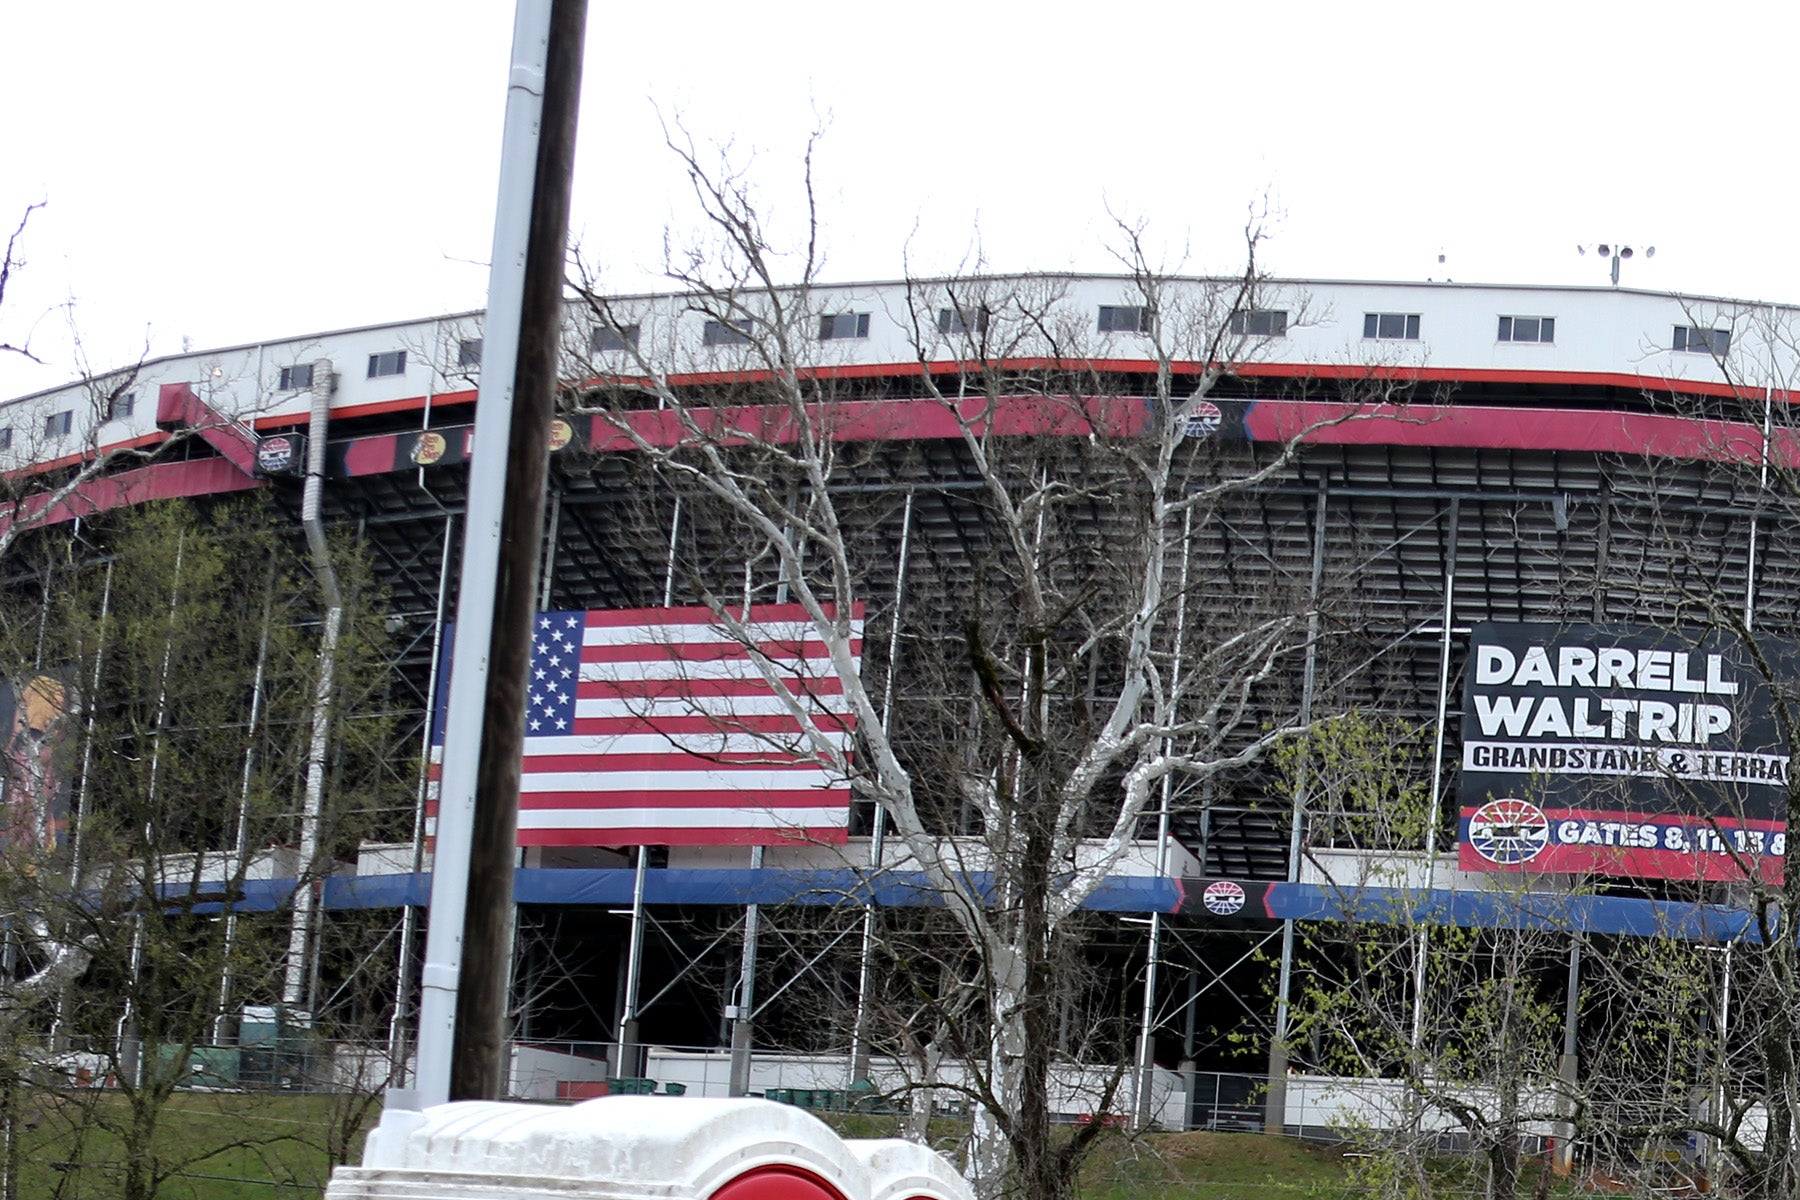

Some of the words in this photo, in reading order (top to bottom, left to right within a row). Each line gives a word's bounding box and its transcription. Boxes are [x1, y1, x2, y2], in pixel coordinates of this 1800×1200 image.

[1475, 644, 1740, 696] DARRELL
[1472, 695, 1733, 745] WALTRIP
[1472, 745, 1658, 772] GRANDSTAND
[1667, 753, 1691, 775] &
[1557, 819, 1659, 849] GATES
[1663, 826, 1691, 855] 8,
[1733, 830, 1765, 854] 13
